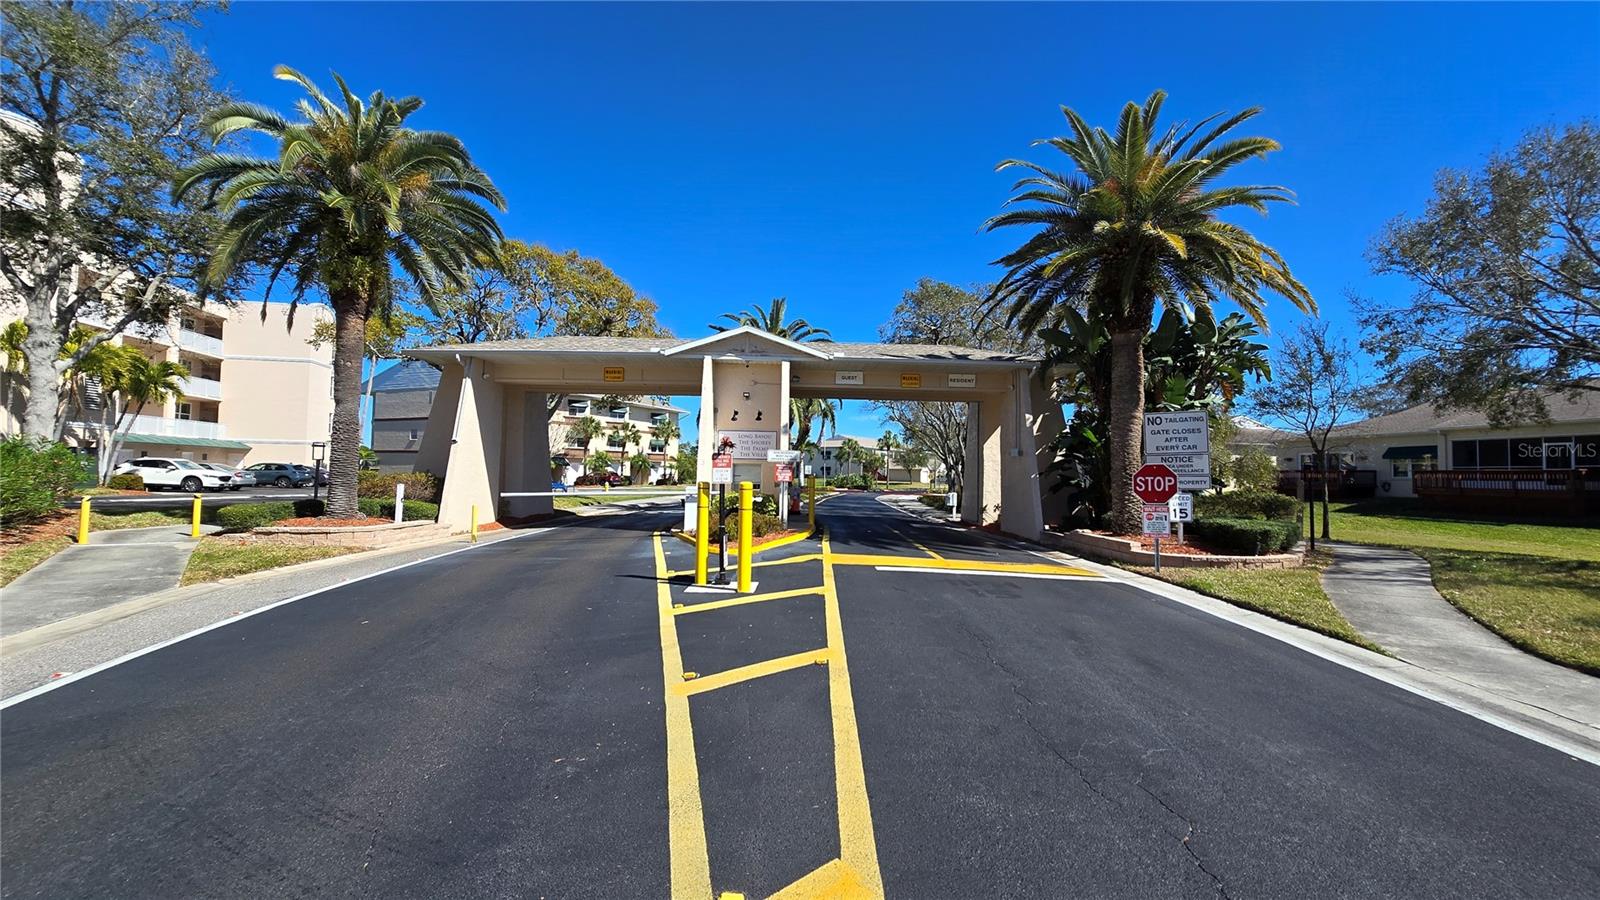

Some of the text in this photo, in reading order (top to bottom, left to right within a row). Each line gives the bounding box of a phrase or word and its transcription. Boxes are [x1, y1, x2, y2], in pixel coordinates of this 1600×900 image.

[1147, 416, 1162, 426] NO
[1136, 476, 1175, 492] STOP
[1173, 508, 1189, 519] 15
